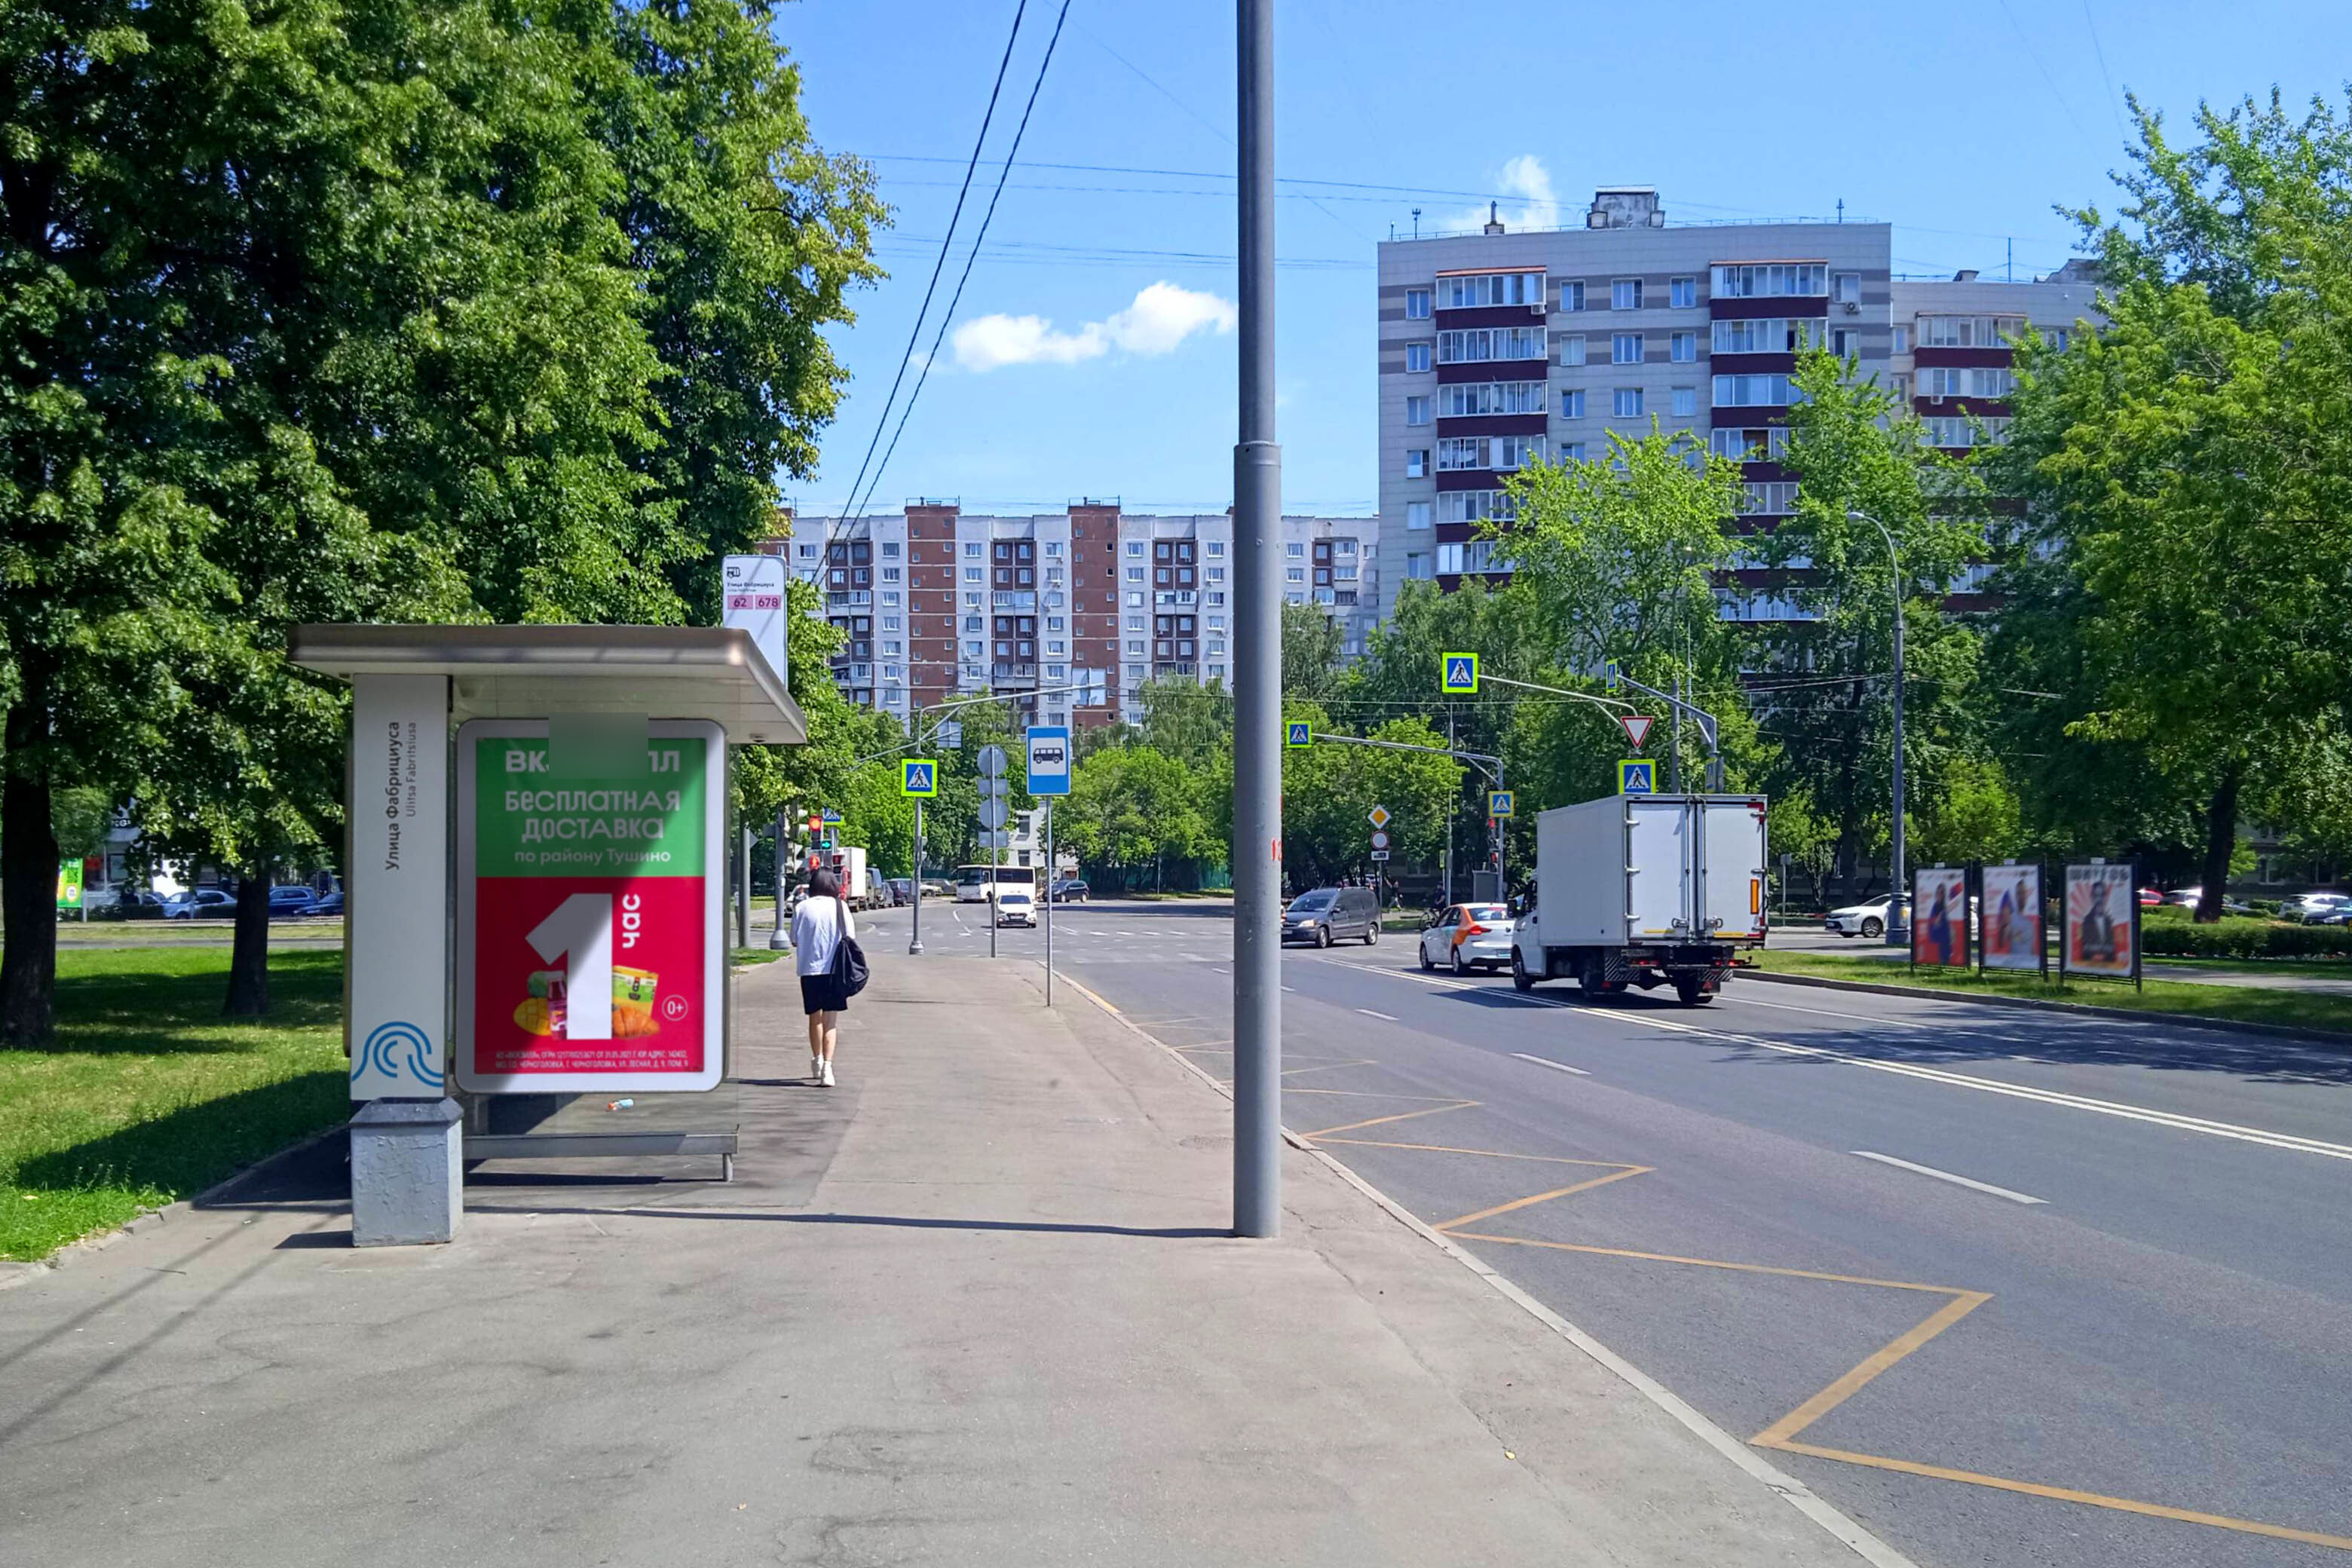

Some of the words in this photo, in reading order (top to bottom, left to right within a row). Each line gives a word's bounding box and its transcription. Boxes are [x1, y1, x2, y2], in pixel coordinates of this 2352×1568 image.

[733, 598, 746, 607] 62
[758, 598, 778, 607] 678
[385, 721, 403, 819] Фабрициуса
[406, 722, 416, 783] Fabritsiusa
[406, 785, 416, 817] Ulitsa
[385, 822, 400, 870] Улица
[515, 851, 536, 862] по
[541, 848, 603, 865] району
[606, 848, 671, 865] Тушино
[622, 894, 641, 948] час
[525, 893, 612, 1040] 1
[667, 1000, 684, 1015] 0+
